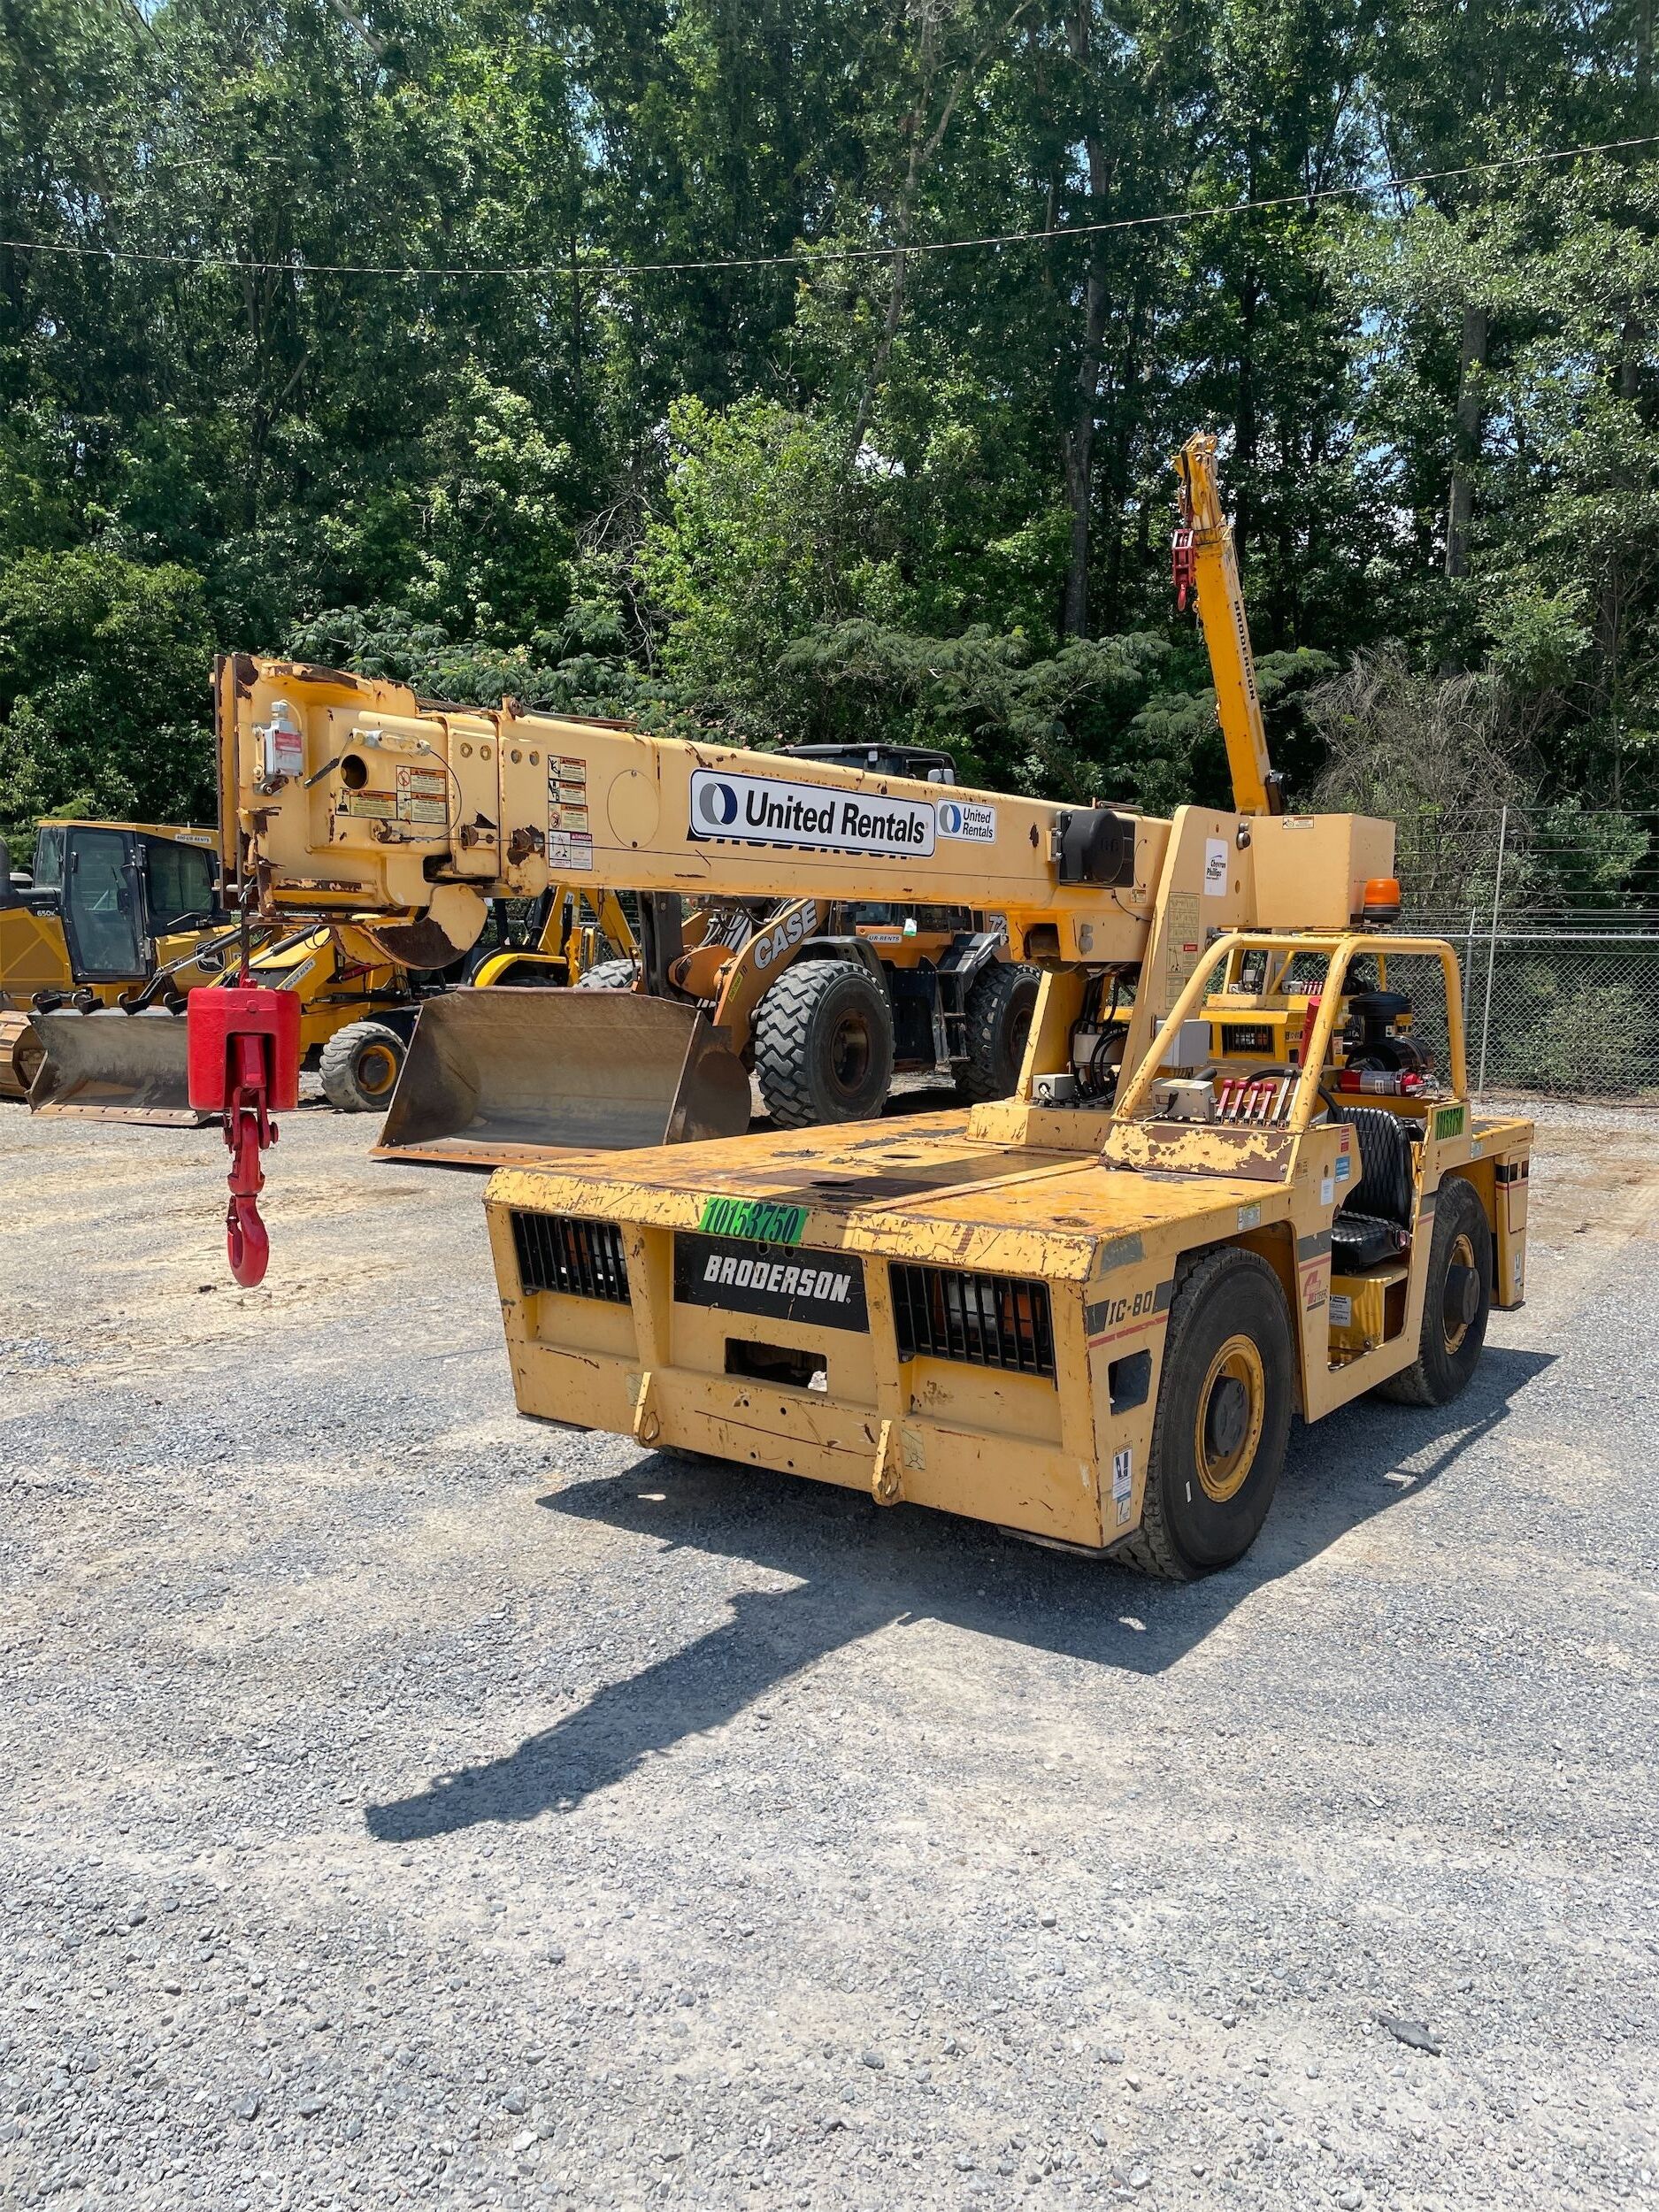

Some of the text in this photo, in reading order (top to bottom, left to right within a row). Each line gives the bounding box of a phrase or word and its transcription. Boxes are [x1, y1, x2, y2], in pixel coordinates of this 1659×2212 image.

[1233, 601, 1255, 700] BRODERSON
[746, 790, 836, 834] United
[841, 803, 926, 844] Rentals
[963, 808, 991, 824] United
[963, 823, 993, 838] Rentals
[753, 898, 818, 970] CASE
[703, 1198, 801, 1245] 10153750
[703, 1254, 852, 1302] BRODERSON
[1109, 1289, 1154, 1326] IC-80
